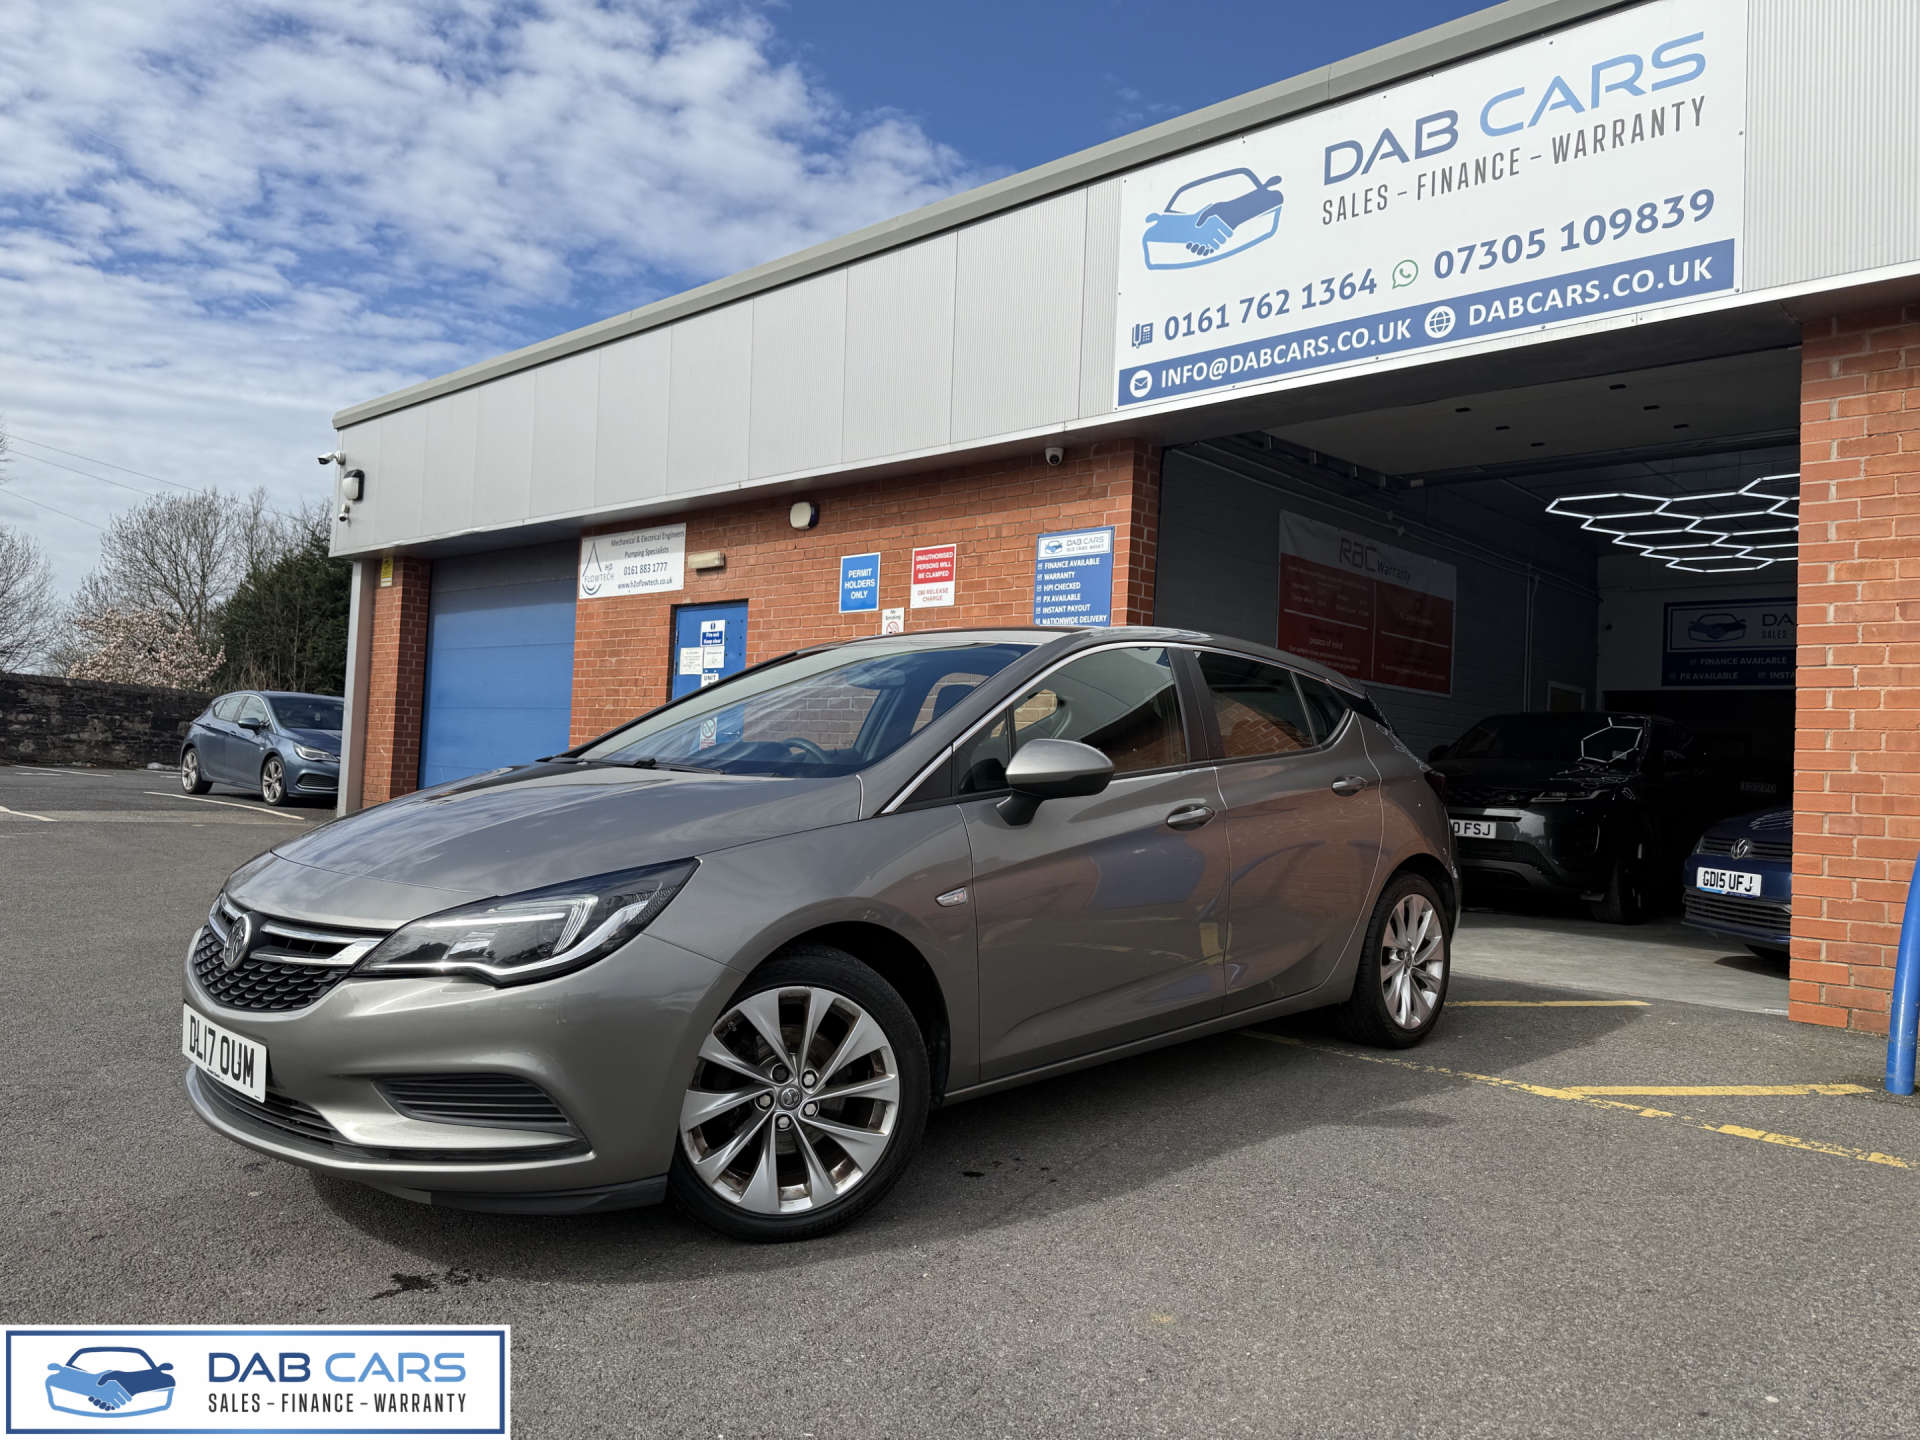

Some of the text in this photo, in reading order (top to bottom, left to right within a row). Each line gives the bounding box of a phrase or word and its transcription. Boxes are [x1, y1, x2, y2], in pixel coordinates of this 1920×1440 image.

[1323, 32, 1706, 185] DAB CARS
[1323, 185, 1387, 225] SALES
[1416, 148, 1521, 201] FINANCE
[1552, 96, 1705, 165] WARRANTY
[1164, 189, 1715, 341] 0161 762 1364 07305 109839
[1161, 257, 1713, 389] INFO@DABCARS.CO.UK DABCARS.CO.UK
[625, 547, 669, 558] Pumping Specialists
[624, 562, 668, 576] 0161 883 1777
[1044, 558, 1100, 570] FINANCE AVAILABLE
[848, 568, 872, 578] PERMIT
[925, 570, 949, 578] CLAMPED
[1044, 572, 1075, 580] WARRANTY
[844, 579, 875, 589] HOLDERS
[1054, 582, 1080, 591] CHECKED
[851, 591, 868, 599] ONLY
[1052, 593, 1080, 602] AVAILABLE
[1043, 604, 1091, 614] INSTANT PAYOUT
[1042, 615, 1107, 625] NATIONWIDE DELIVERY
[1762, 613, 1794, 626] DA
[1700, 656, 1787, 665] FINANCE AVAILABLE
[1464, 823, 1490, 836] FSJ
[1703, 871, 1752, 892] GD15 UFJ
[189, 1014, 254, 1089] DL17 OUM
